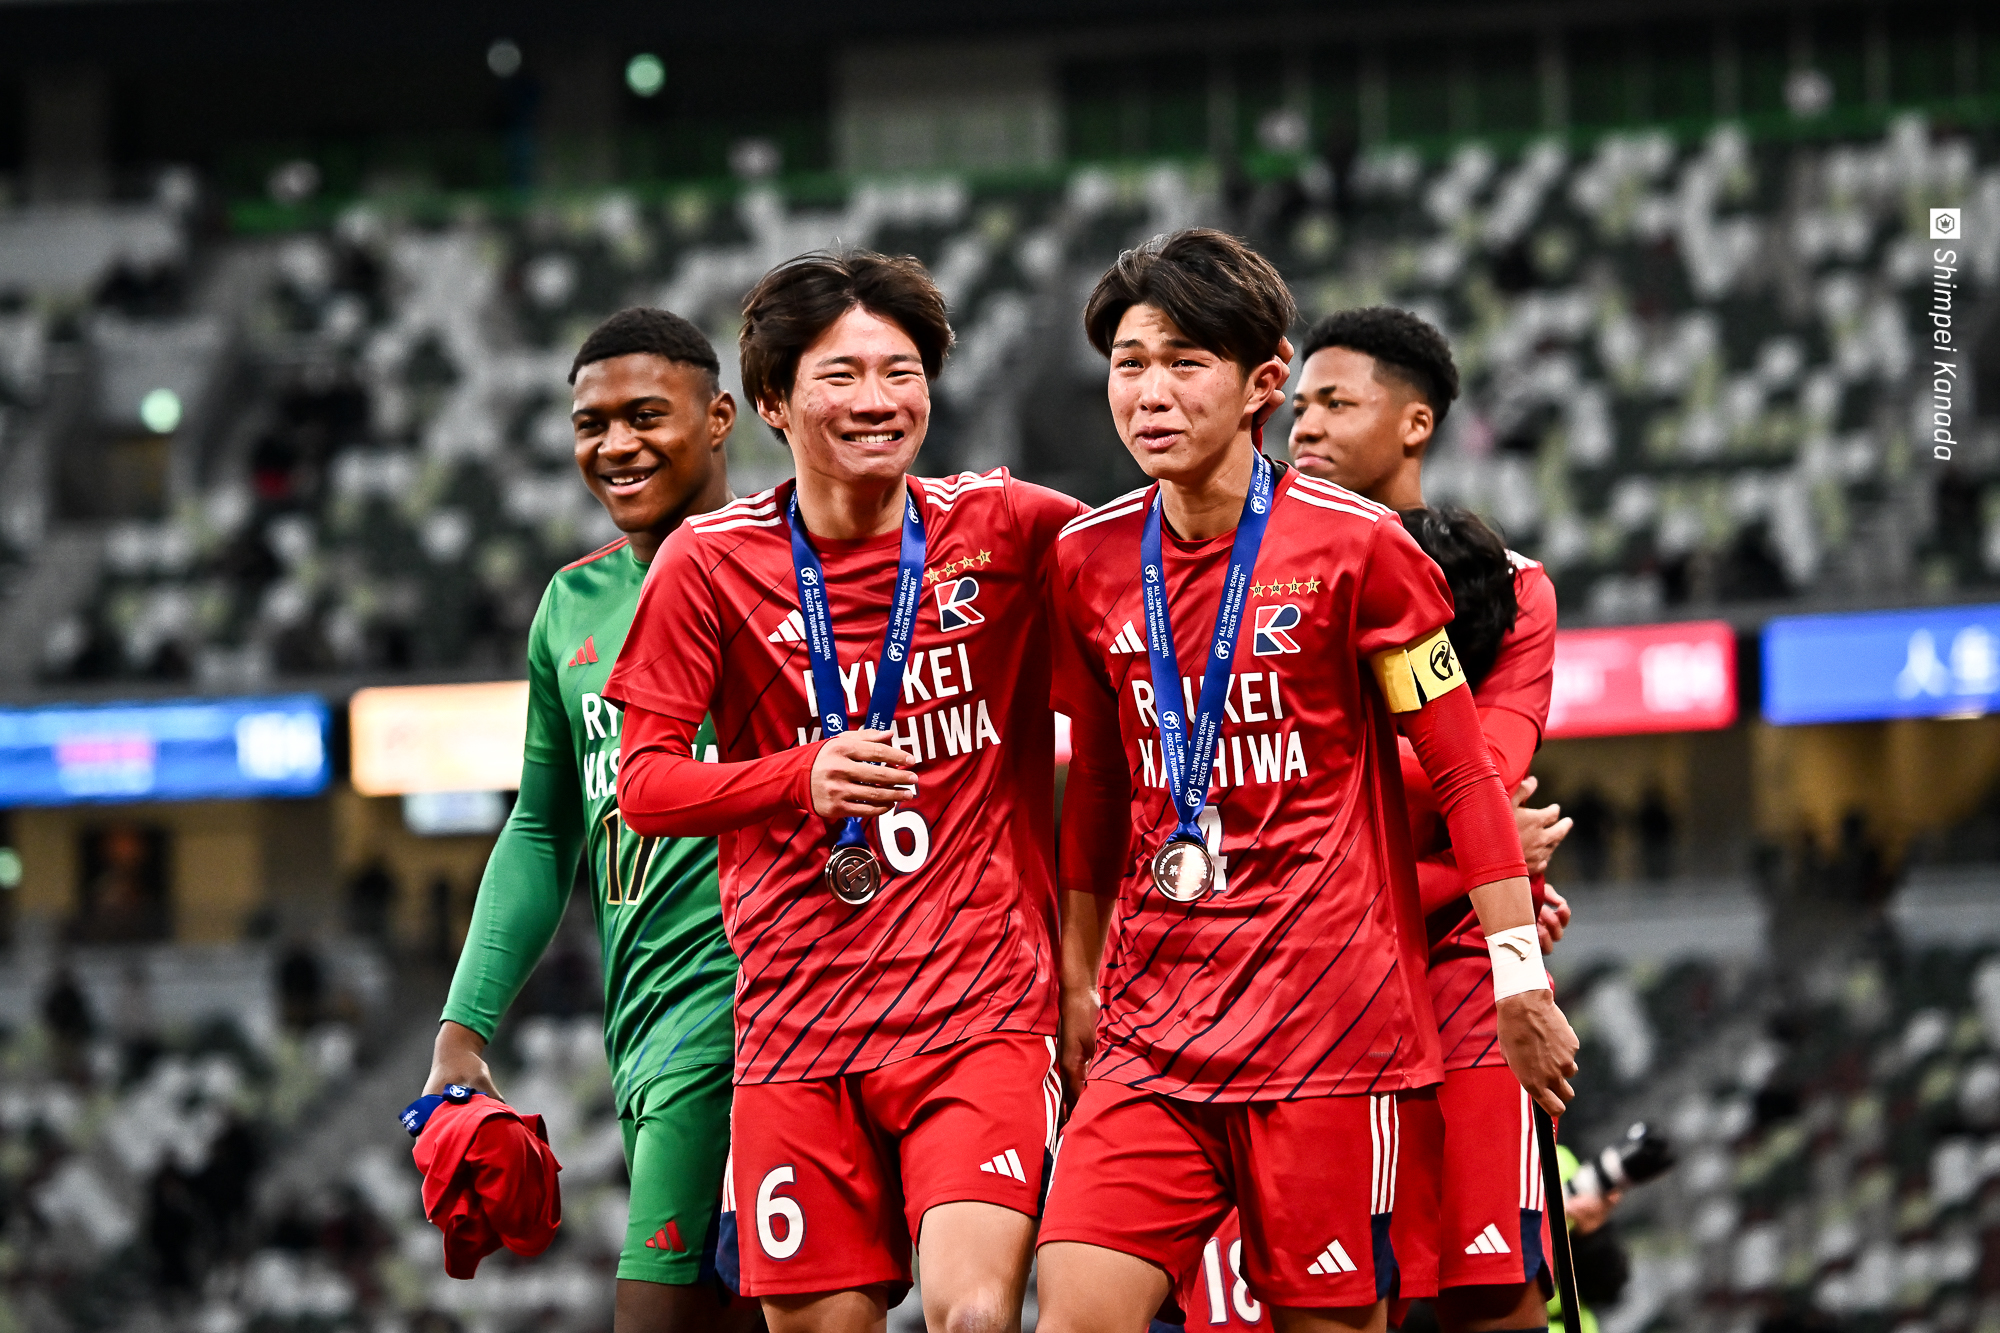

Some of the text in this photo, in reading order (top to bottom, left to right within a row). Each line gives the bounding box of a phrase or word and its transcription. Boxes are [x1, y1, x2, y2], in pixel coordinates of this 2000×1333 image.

[1230, 564, 1241, 588] SCHOOL
[815, 600, 824, 620] JAPAN
[891, 568, 910, 639] ALL JAPAN HIGH SCHOOL
[900, 577, 917, 641] SOCCER TOURNAMENT
[1226, 588, 1235, 604] HIGH
[1227, 573, 1246, 638] SOCCER TOURNAMENT
[804, 589, 821, 653] SOCCER TOURNAMENT
[819, 621, 827, 636] HIGH
[1222, 604, 1231, 625] JAPAN
[1149, 611, 1160, 651] TOURNAMENT
[1160, 634, 1169, 658] SCHOOL
[822, 636, 831, 661] SCHOOL
[1166, 732, 1175, 756] SOCCER
[1177, 745, 1185, 764] JAPAN
[1189, 712, 1209, 785] ALL JAPAN HIGH SCHOOL
[1198, 721, 1216, 786] SOCCER TOURNAMENT
[876, 783, 932, 875] 6
[402, 1110, 418, 1124] CHOOL
[755, 1163, 807, 1262] 6
[1202, 1236, 1262, 1326] 18
